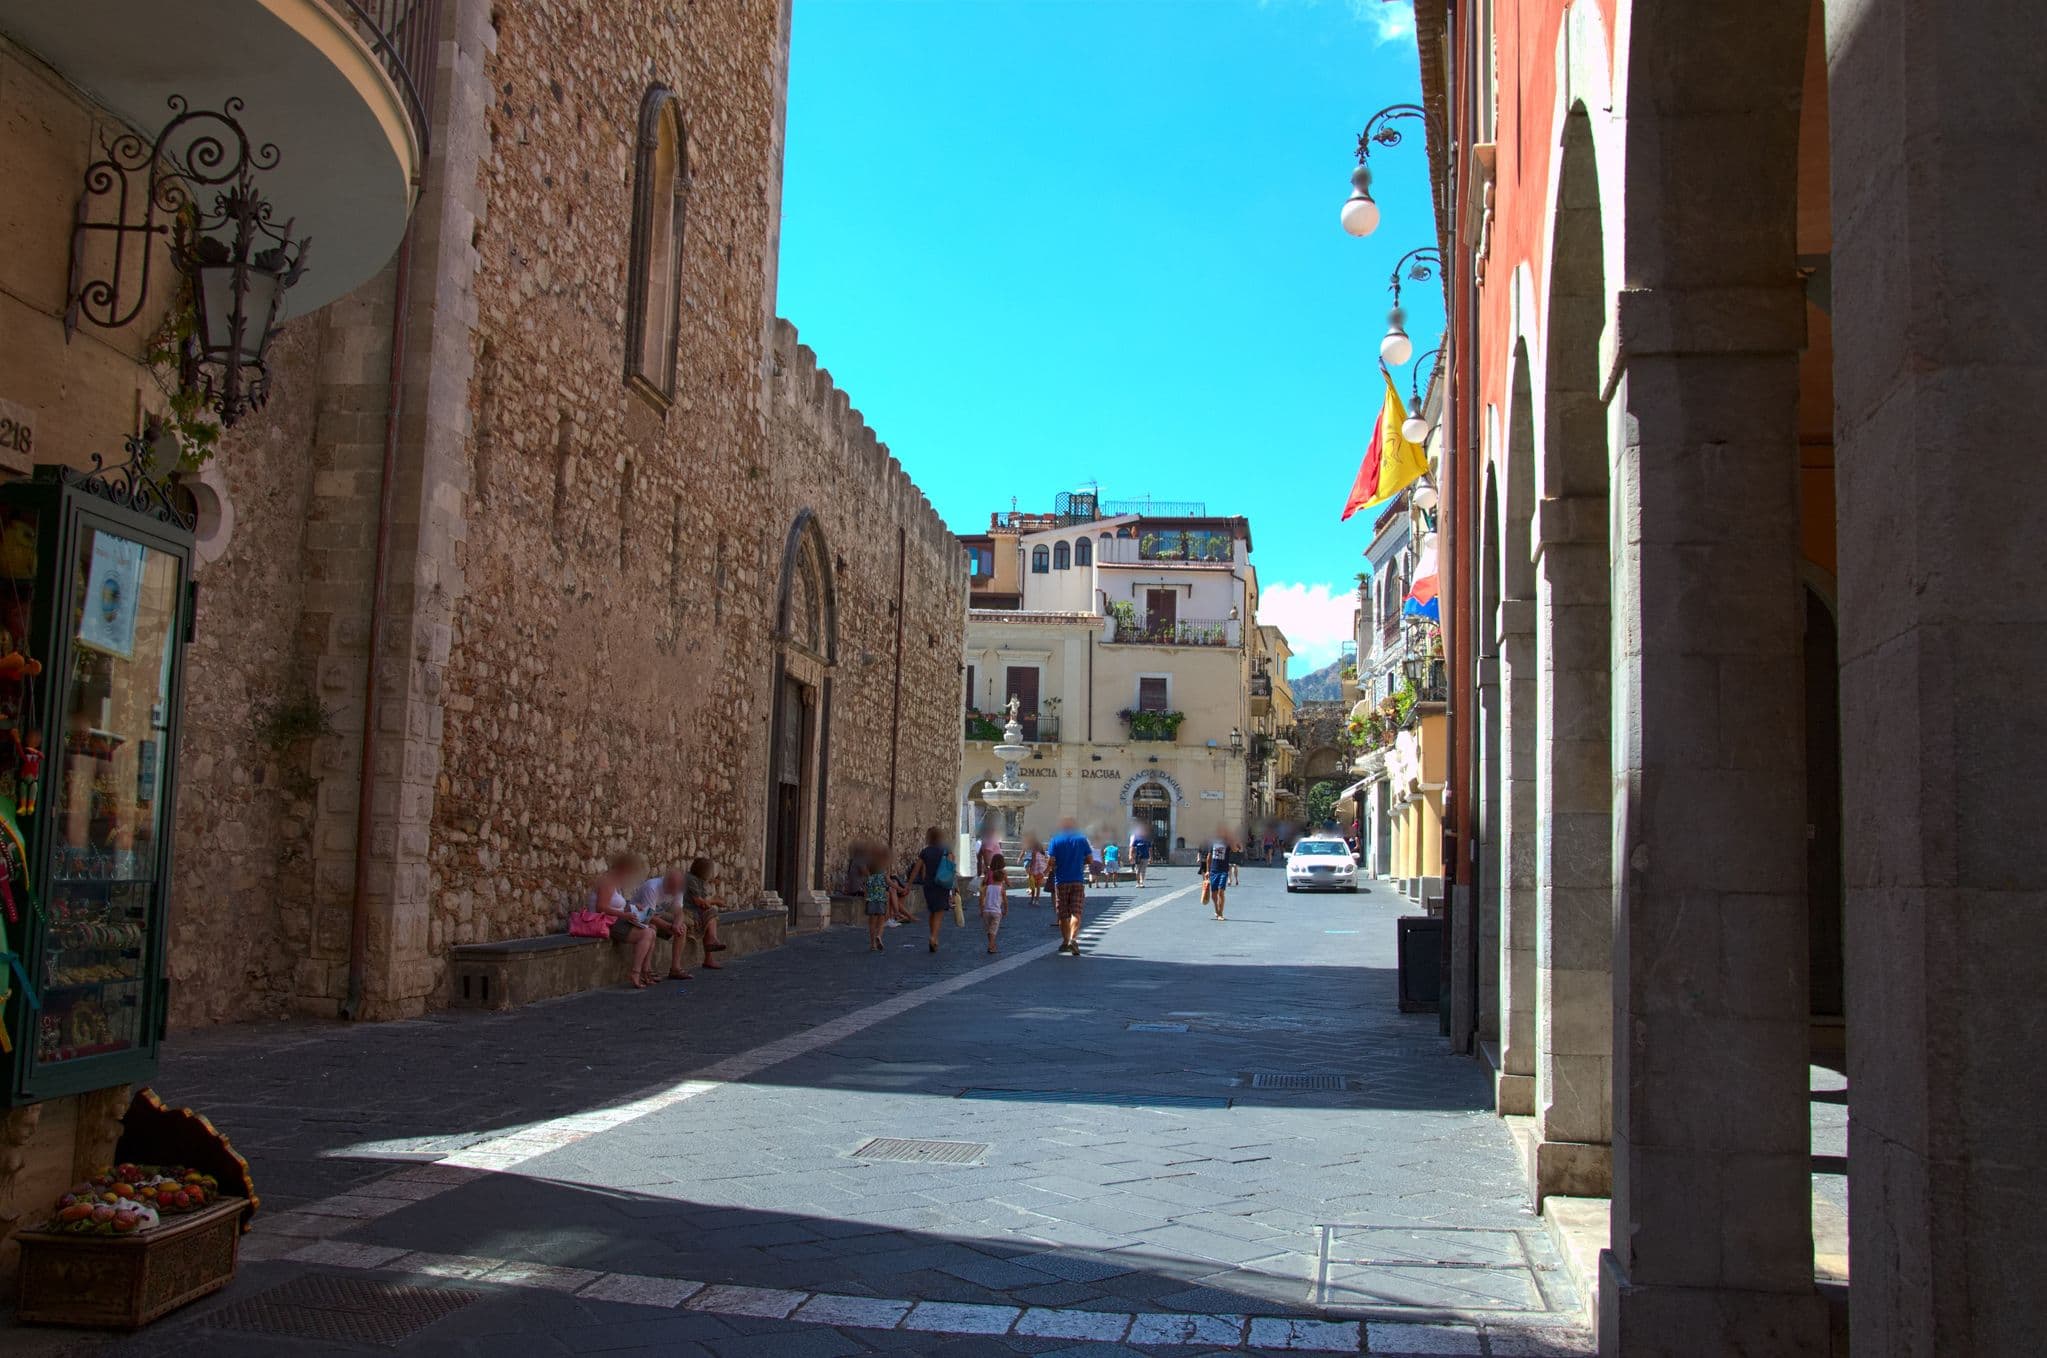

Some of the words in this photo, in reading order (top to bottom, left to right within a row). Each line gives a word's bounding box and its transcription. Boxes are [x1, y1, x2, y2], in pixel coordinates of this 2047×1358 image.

[0, 418, 31, 454] 218
[1017, 767, 1058, 778] RMACIA
[1081, 768, 1121, 779] RAGUSA
